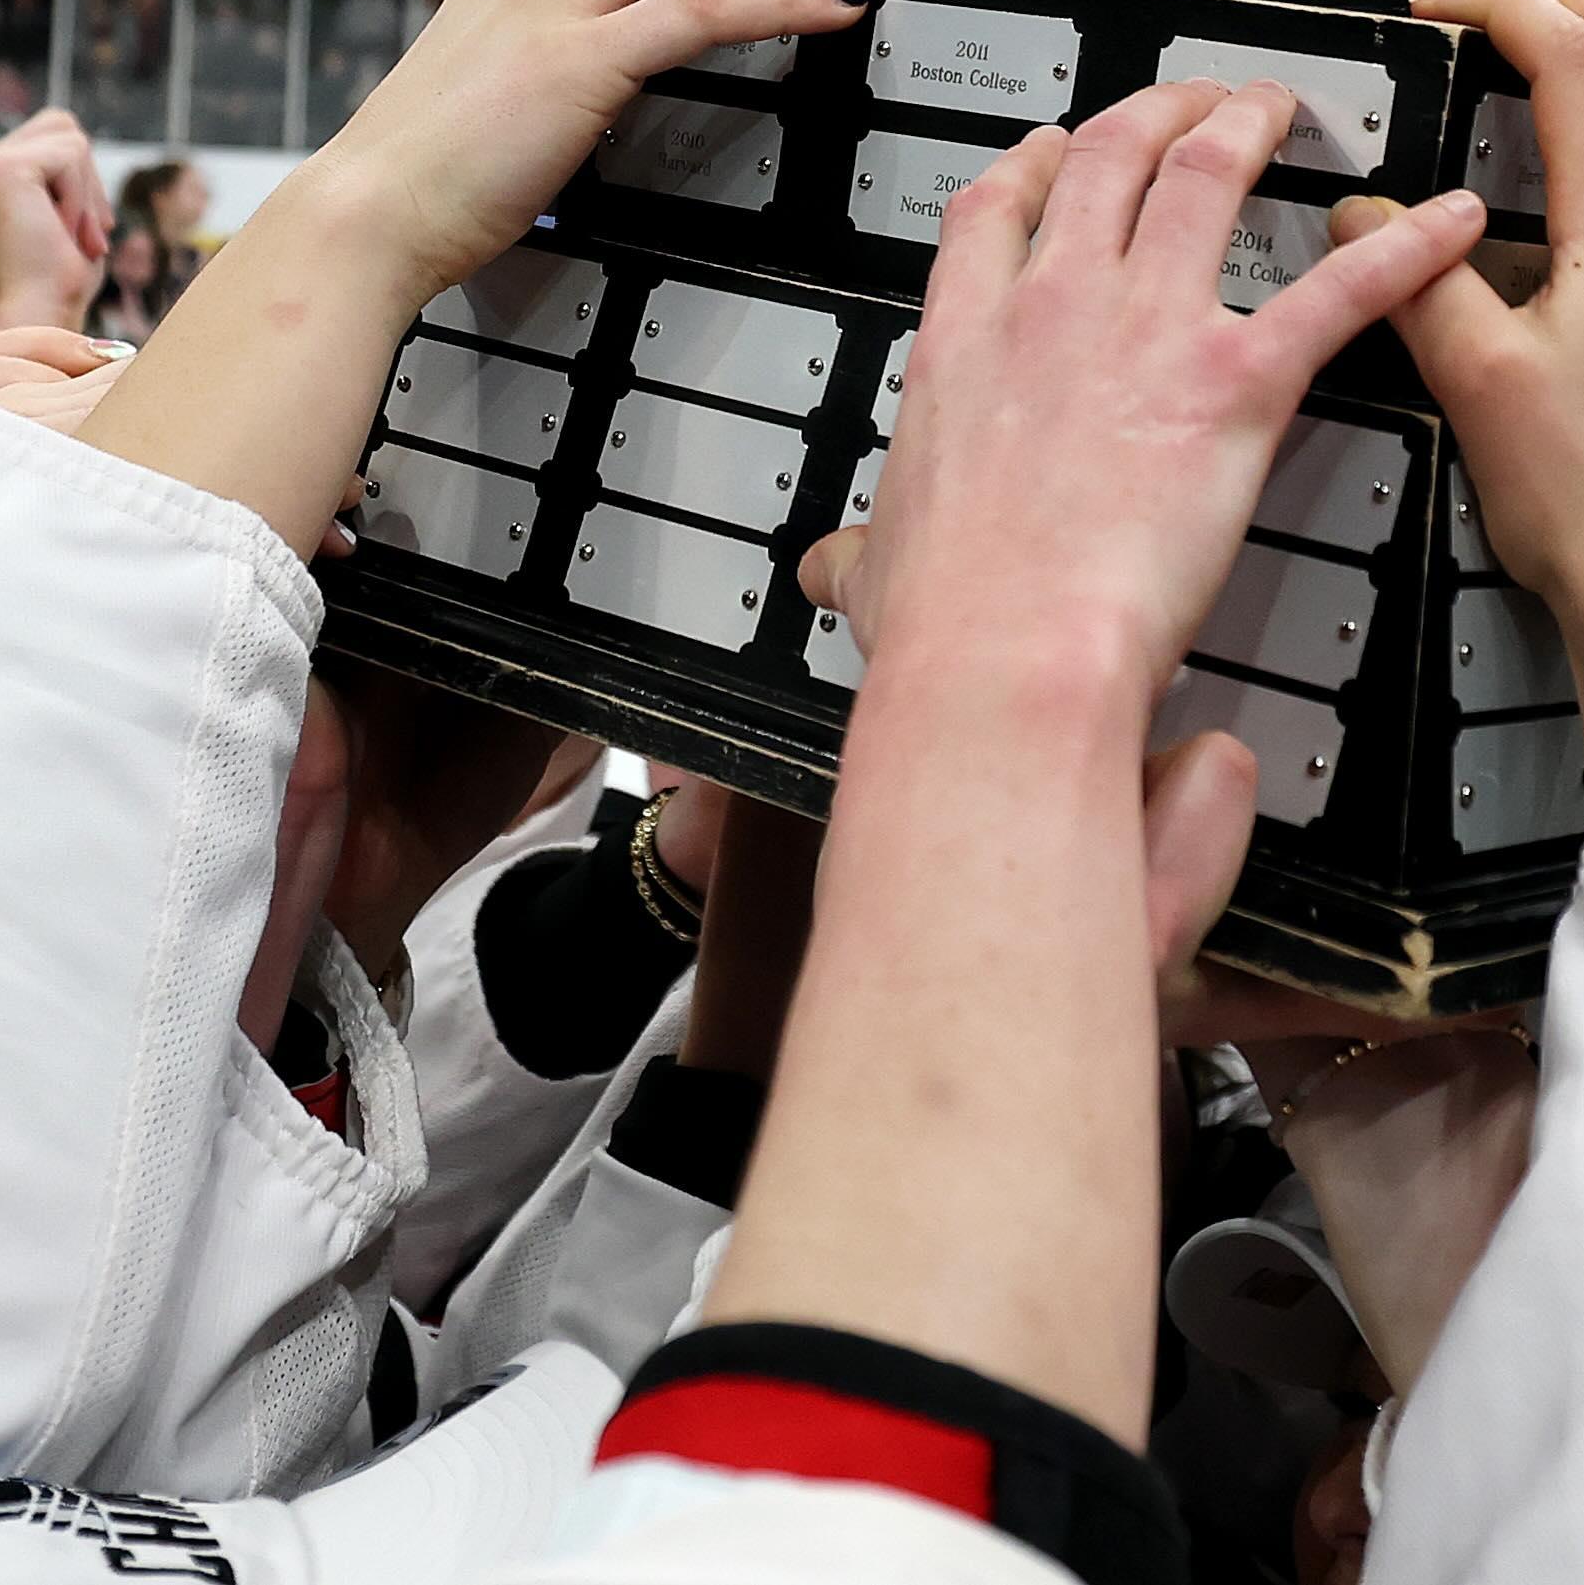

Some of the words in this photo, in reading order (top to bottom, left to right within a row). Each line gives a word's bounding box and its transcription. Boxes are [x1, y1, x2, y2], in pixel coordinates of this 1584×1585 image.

[955, 40, 990, 61] 2011
[910, 61, 963, 85] Boston
[969, 68, 1027, 96] College
[1231, 229, 1274, 254] 2014
[1249, 262, 1301, 286] Colle
